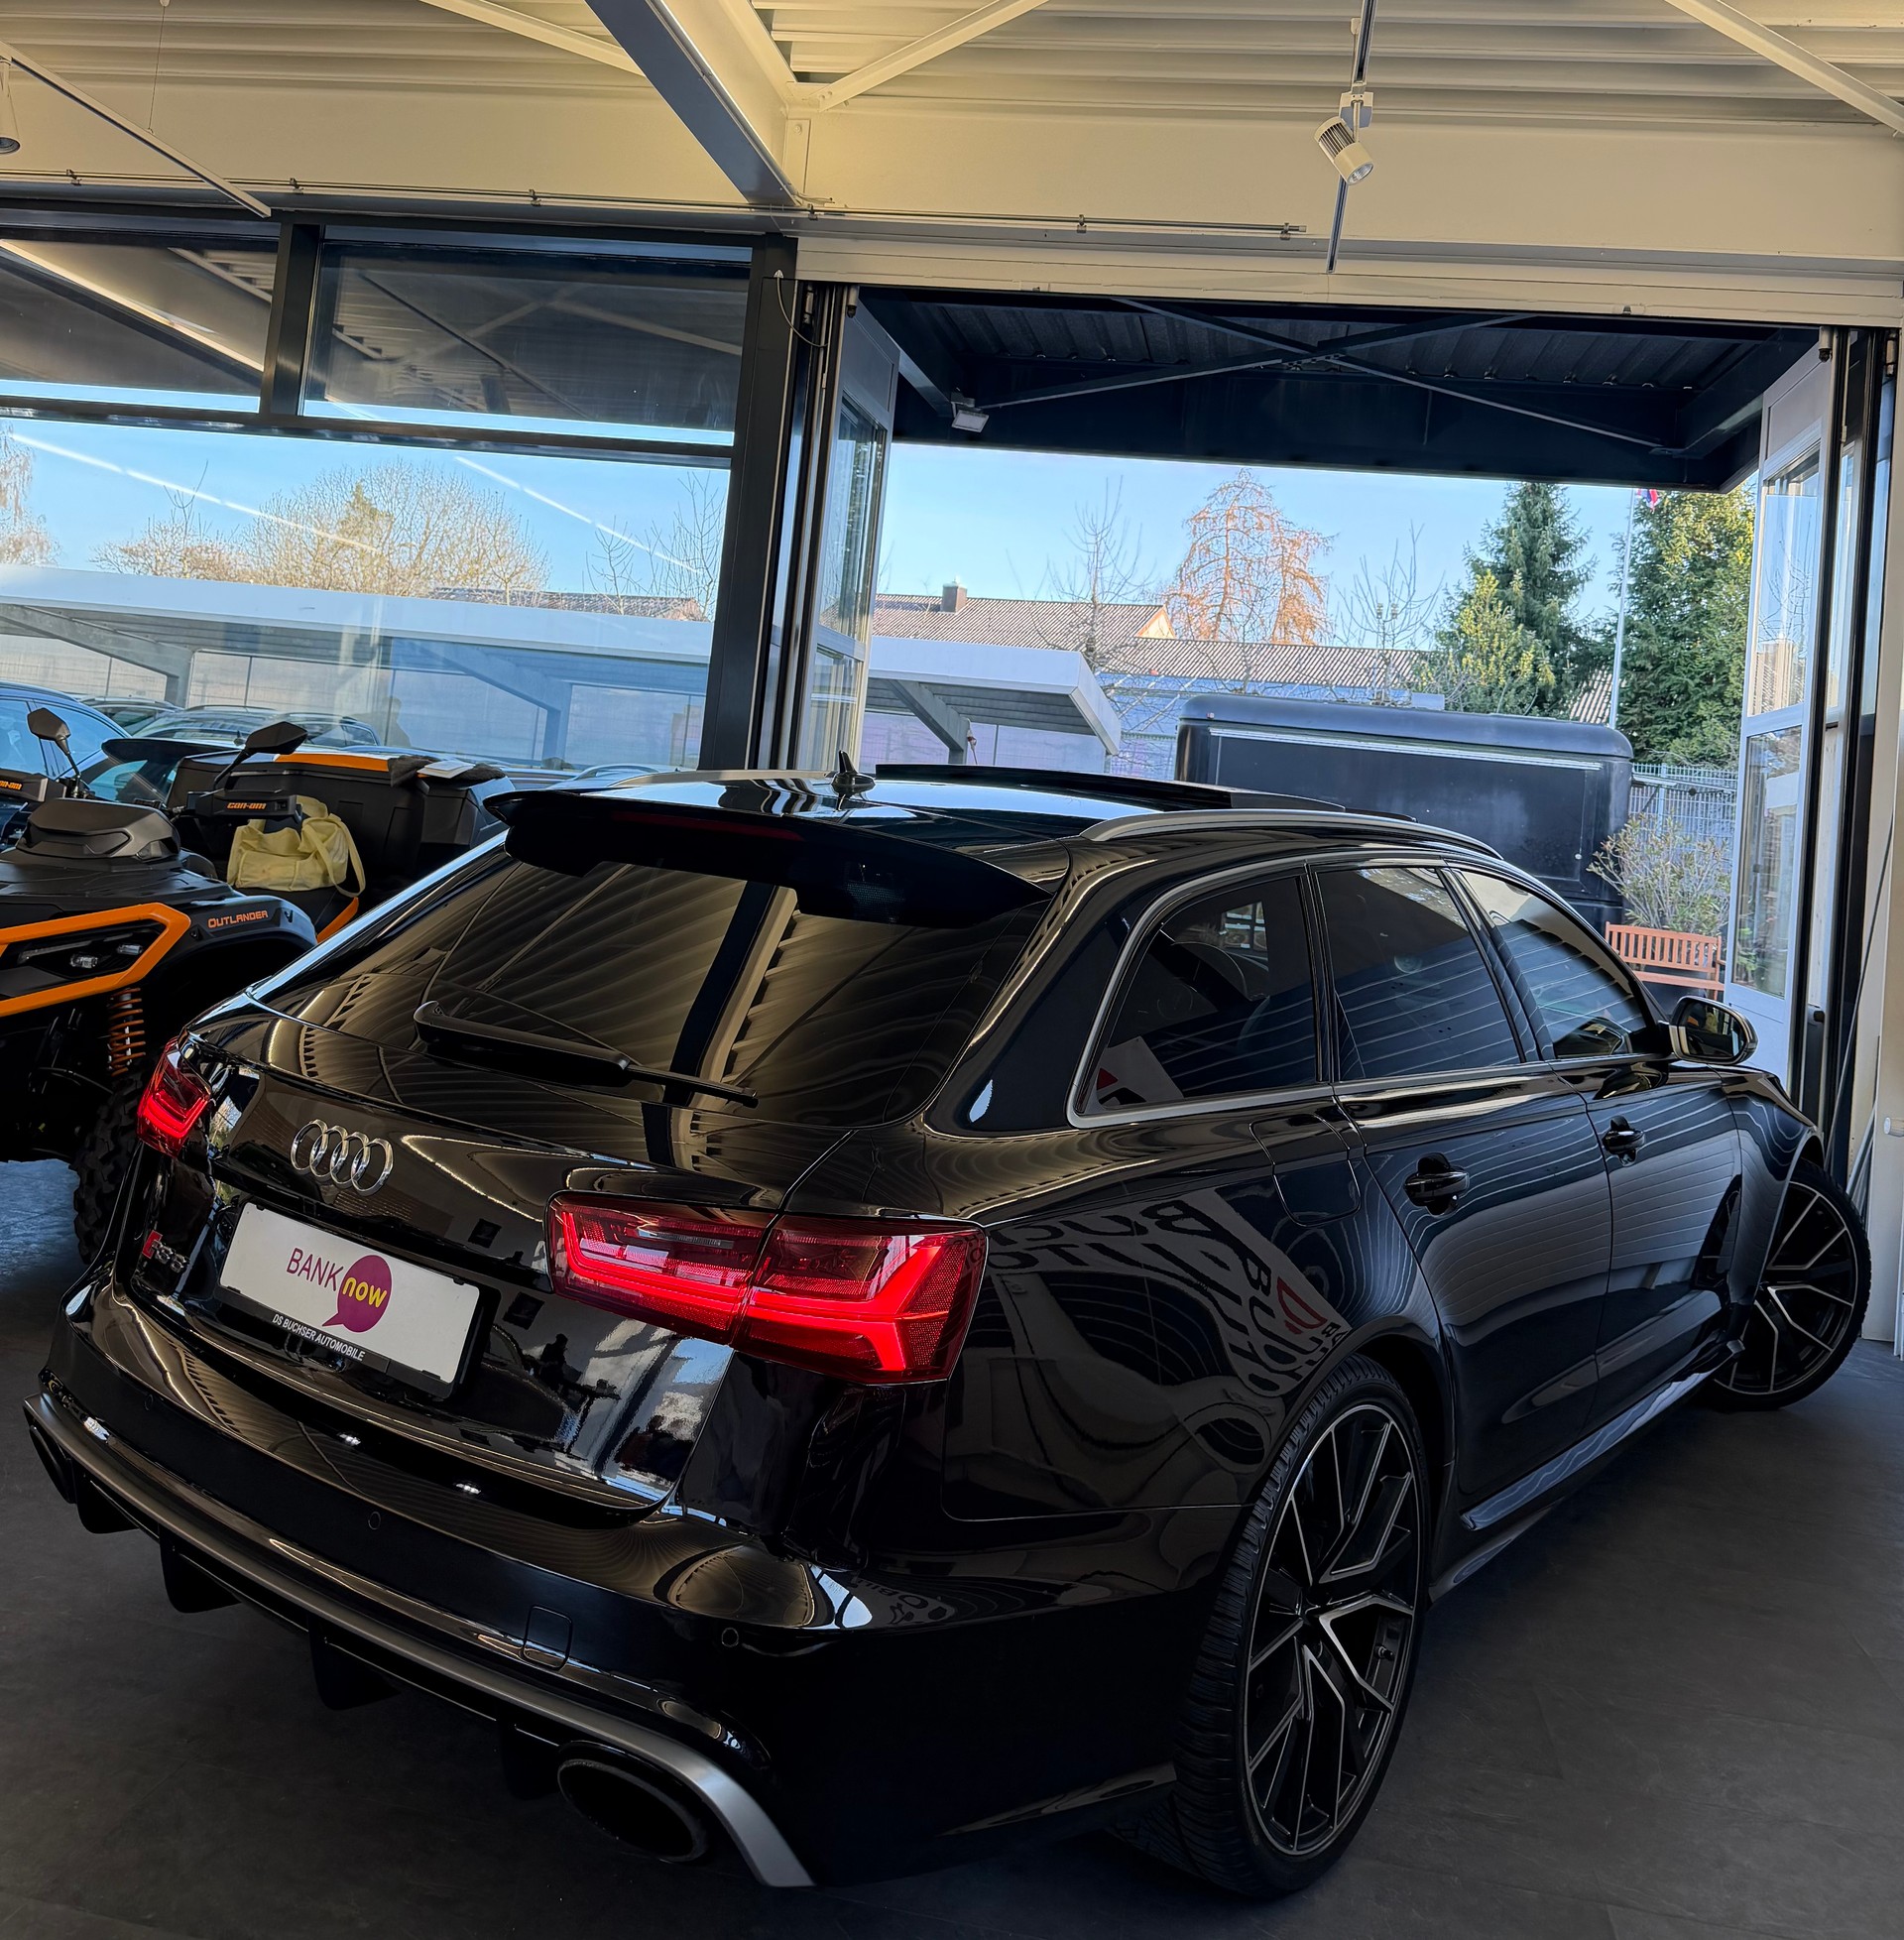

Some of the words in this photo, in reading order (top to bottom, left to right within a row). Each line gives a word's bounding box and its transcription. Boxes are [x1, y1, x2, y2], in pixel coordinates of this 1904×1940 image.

[208, 910, 269, 928] OUTLANDER
[287, 1247, 344, 1292] BANK
[342, 1276, 388, 1308] now
[272, 1313, 284, 1326] DS
[283, 1317, 317, 1341] BUCHSER
[315, 1333, 366, 1362] AUTOMOBILE
